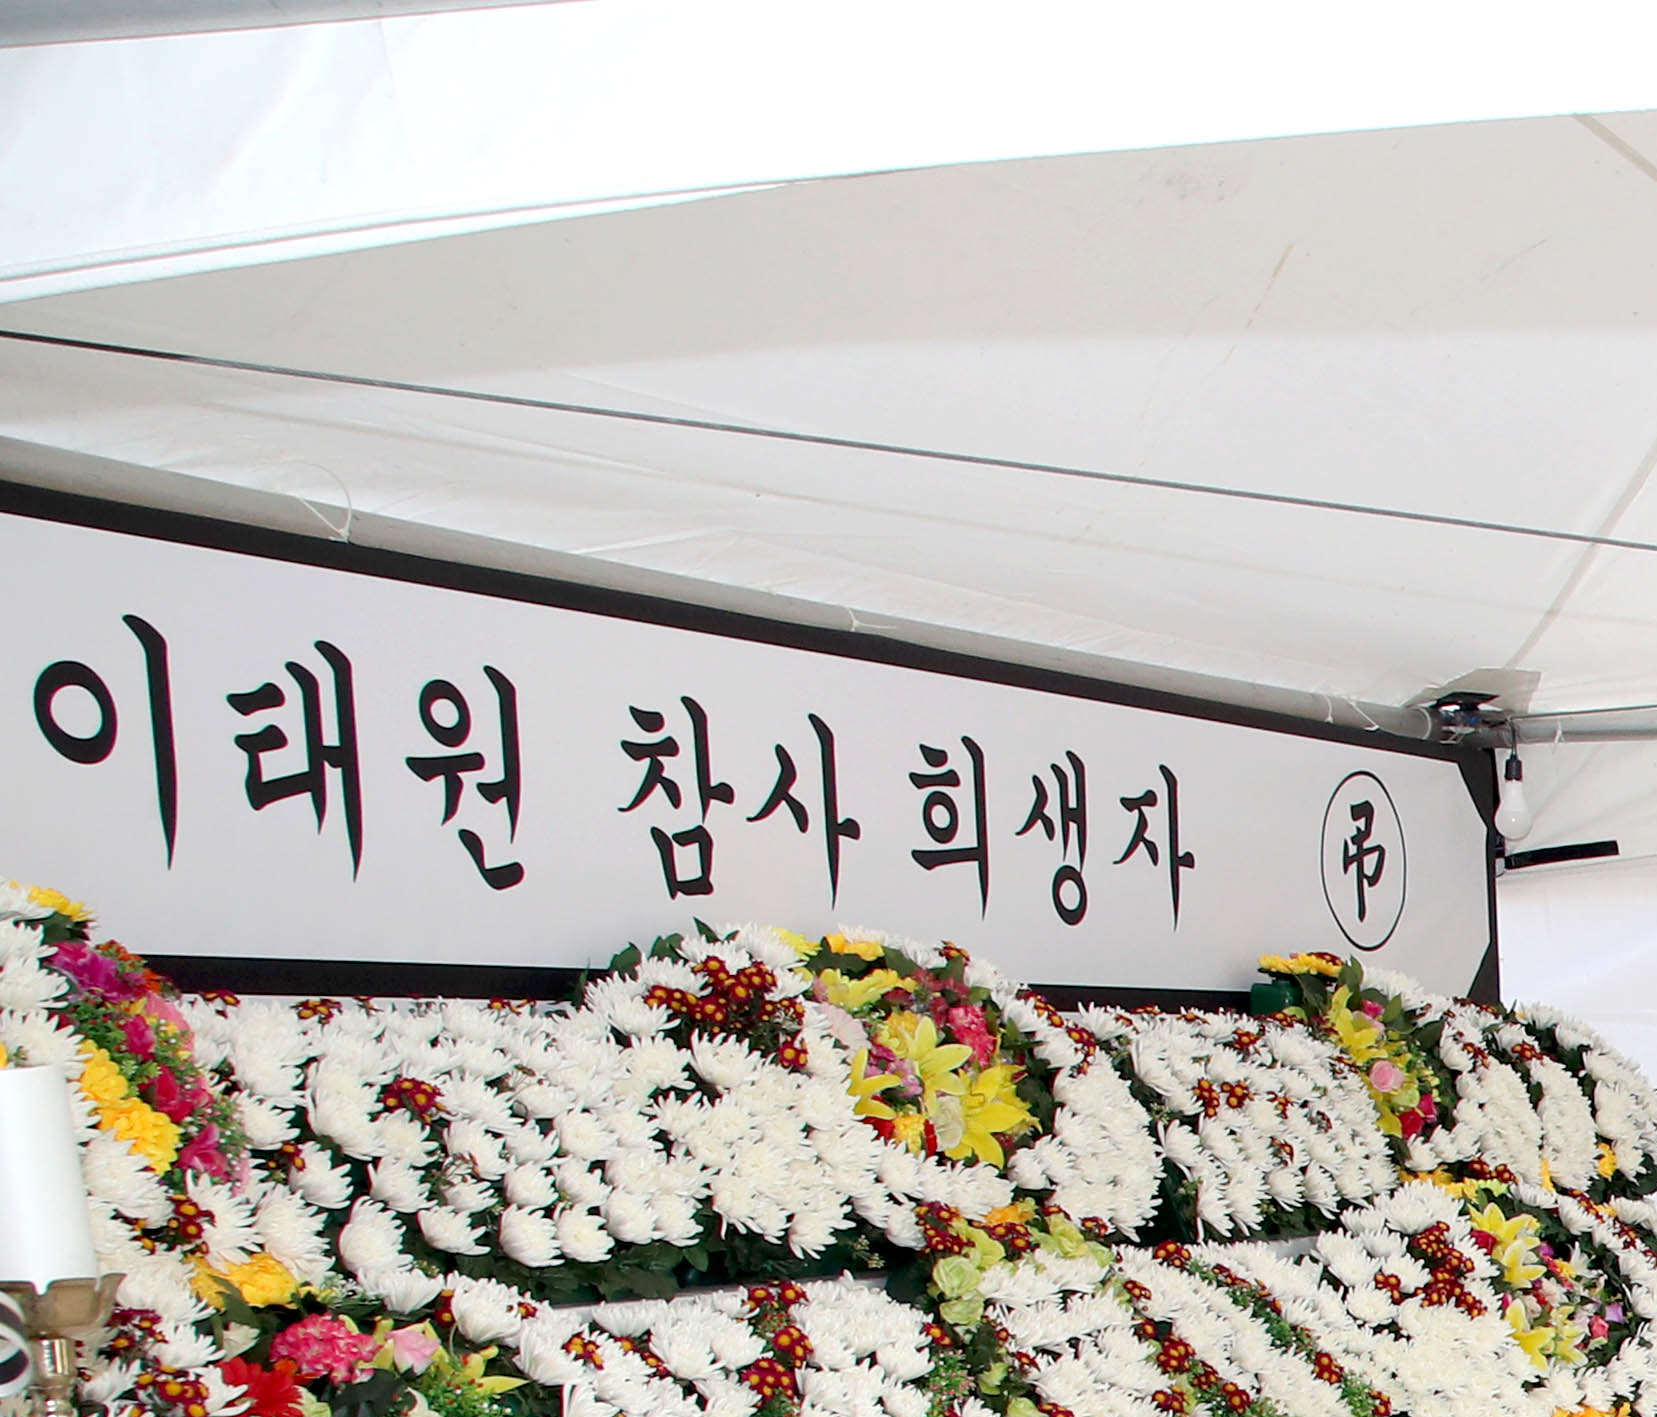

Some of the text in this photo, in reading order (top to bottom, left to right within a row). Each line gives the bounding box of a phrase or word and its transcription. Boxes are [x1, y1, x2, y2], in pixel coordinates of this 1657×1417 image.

[33, 613, 1196, 934] 이태원 참사 희생자
